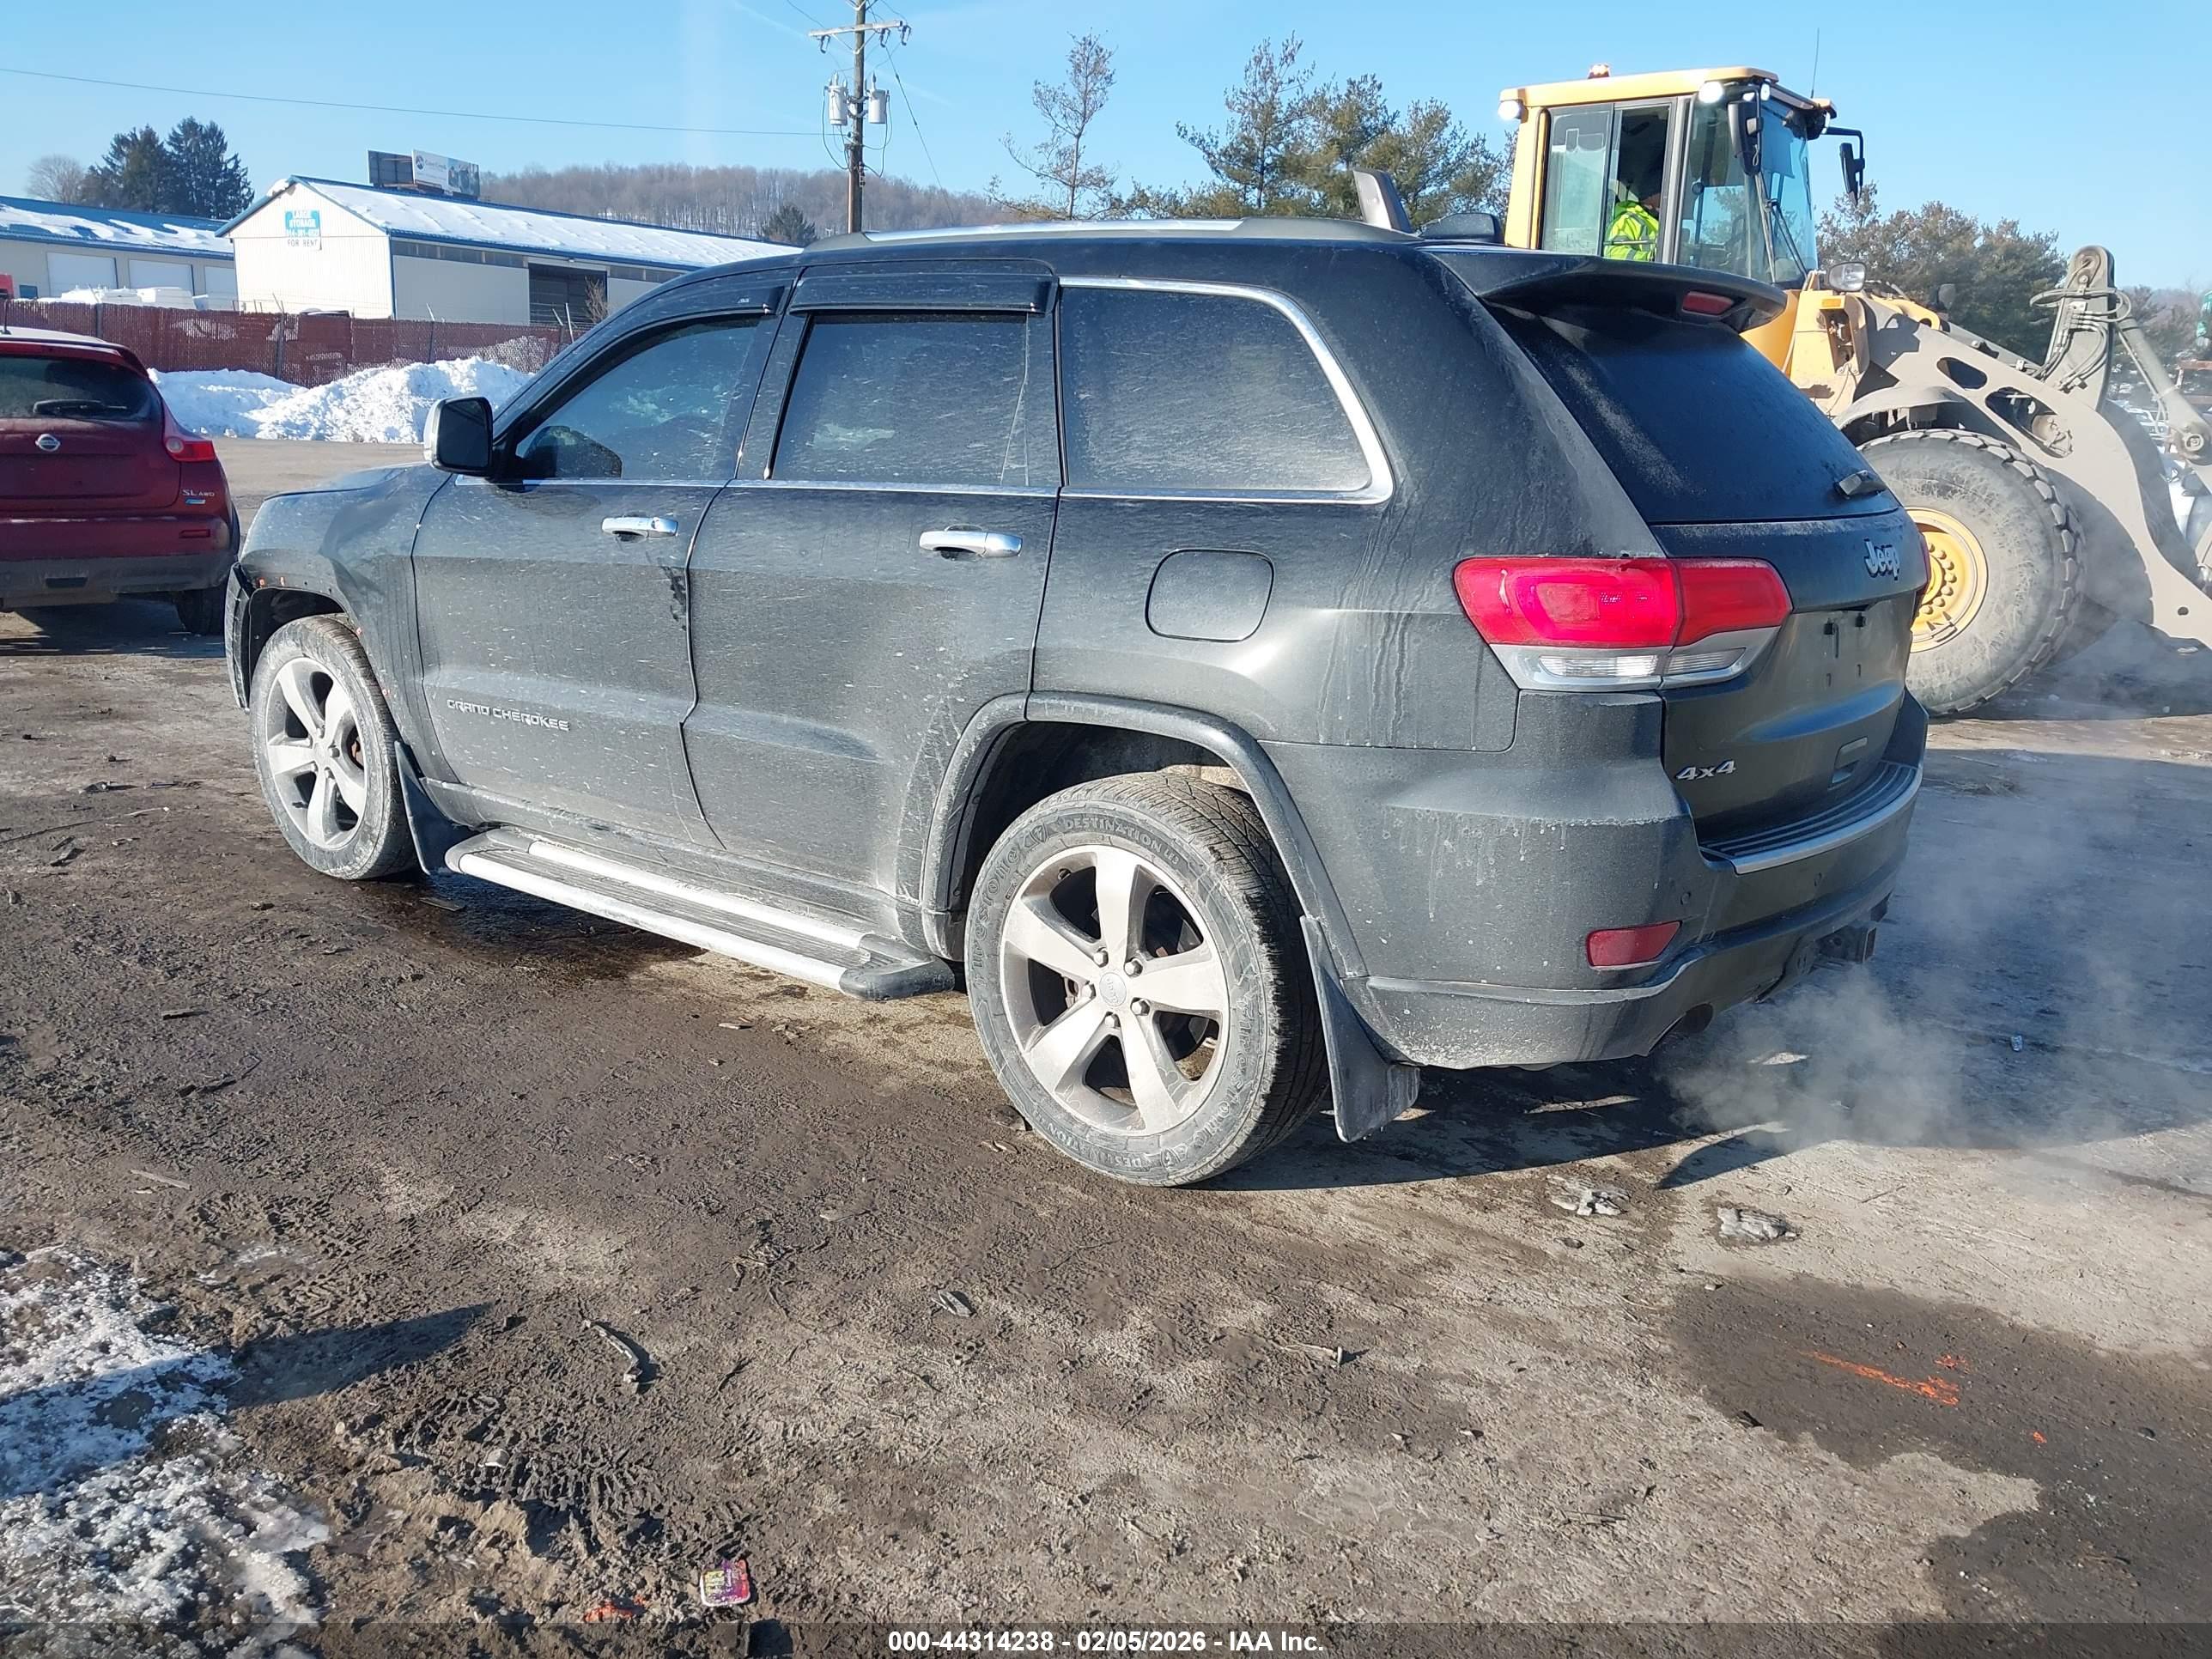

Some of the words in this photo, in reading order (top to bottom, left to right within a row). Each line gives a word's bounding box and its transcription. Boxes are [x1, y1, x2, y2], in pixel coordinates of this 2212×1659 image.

[287, 239, 300, 247] FOR
[302, 239, 319, 247] RENT
[1864, 538, 1900, 579] Jeep
[447, 699, 490, 714] GRAND
[492, 706, 570, 731] CHEROKEE
[1675, 760, 1736, 781] 4x4
[1064, 816, 1162, 853] DESTINATION
